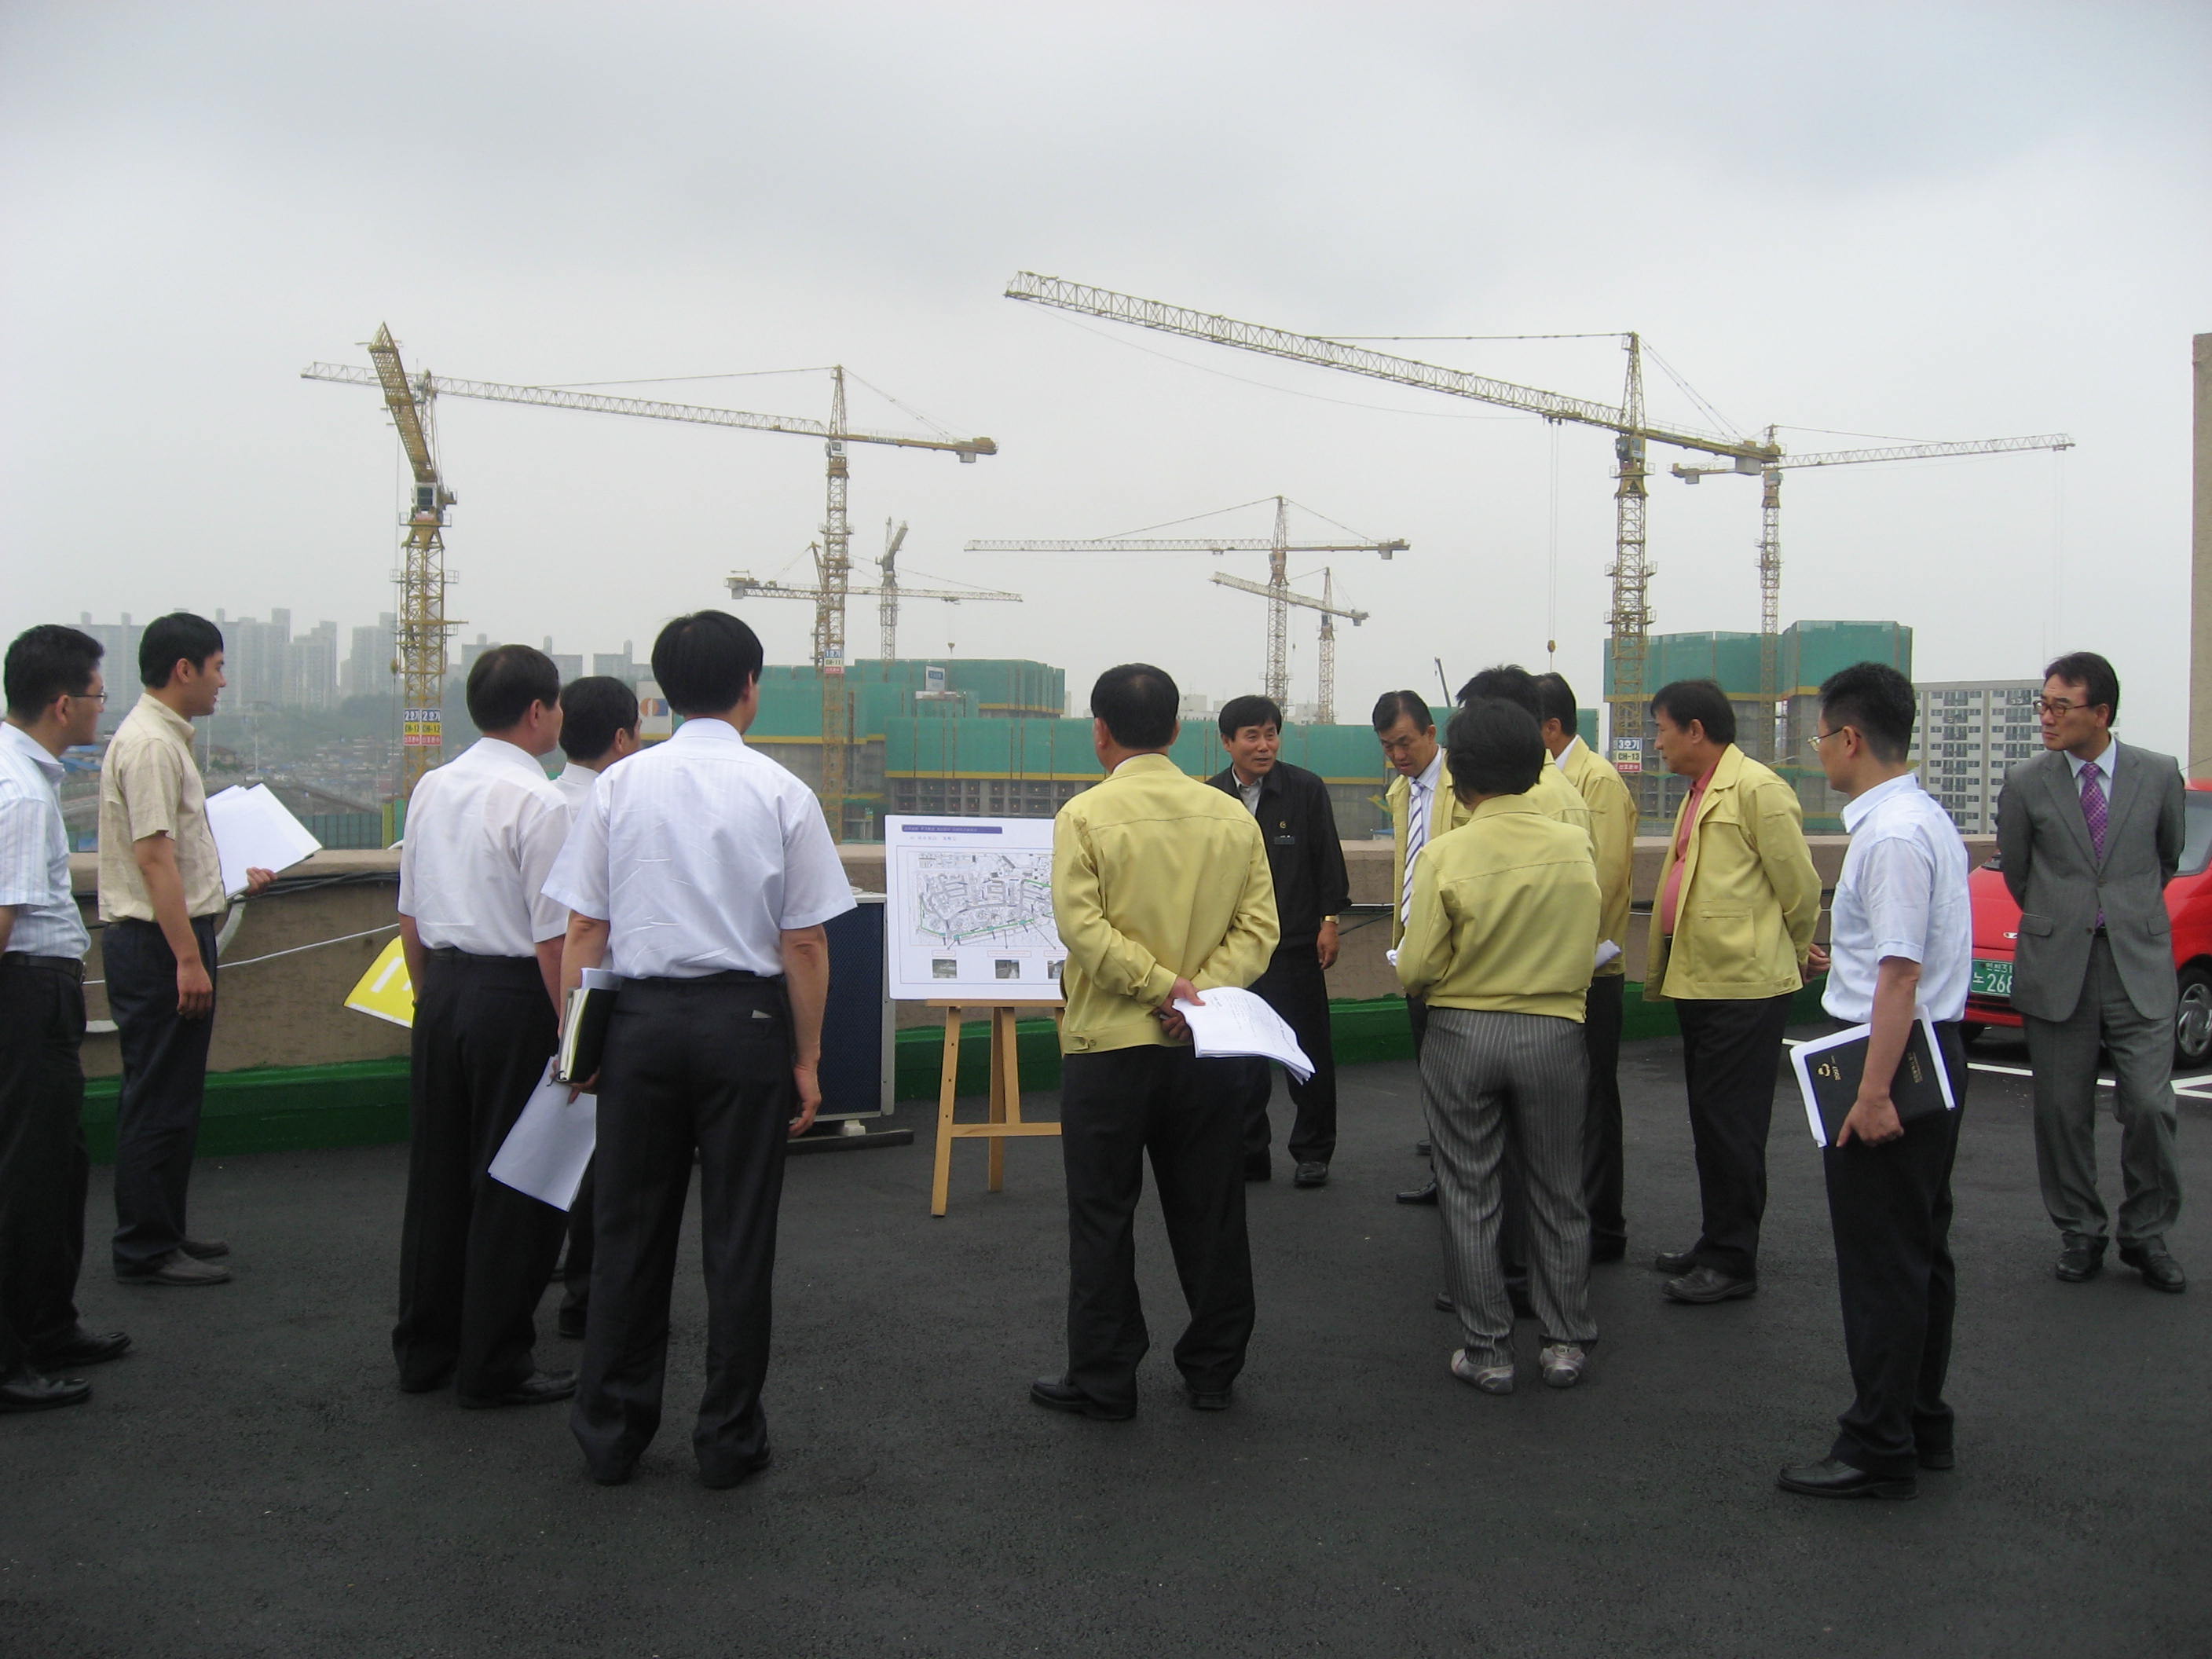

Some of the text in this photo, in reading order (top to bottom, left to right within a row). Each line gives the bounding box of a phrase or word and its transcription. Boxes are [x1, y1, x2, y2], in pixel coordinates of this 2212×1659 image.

[405, 710, 420, 721] 2호기
[422, 710, 441, 721] 2호기
[1618, 739, 1640, 750] 3호기
[1972, 972, 1984, 983] 노
